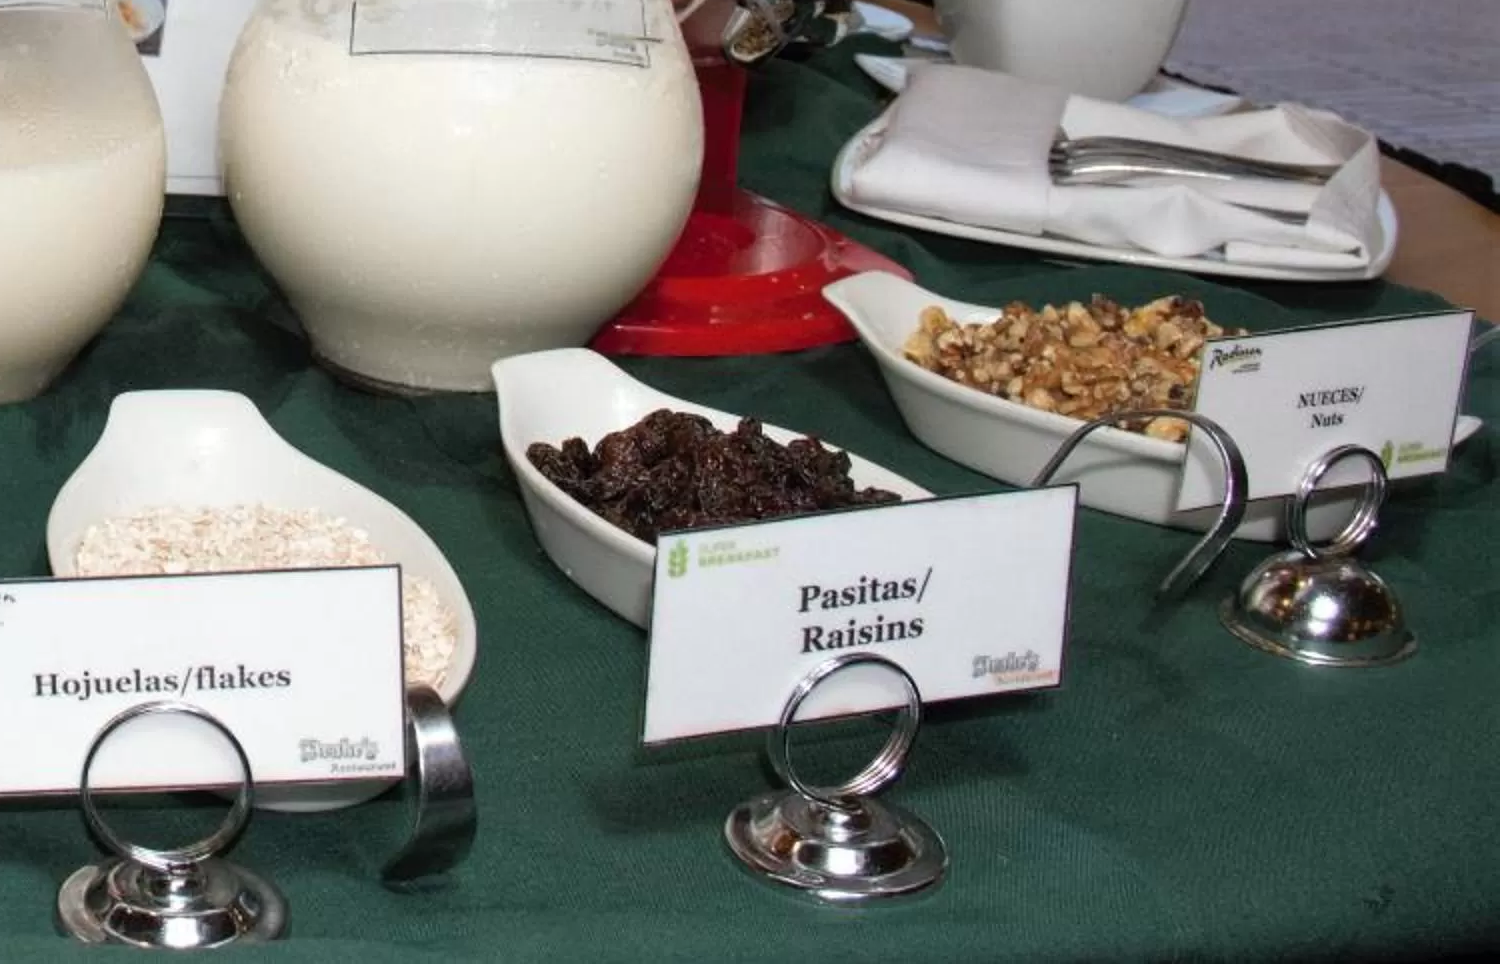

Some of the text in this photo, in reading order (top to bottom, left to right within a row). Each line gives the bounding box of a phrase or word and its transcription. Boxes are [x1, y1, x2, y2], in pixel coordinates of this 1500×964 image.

[1297, 386, 1365, 409] NUECES/
[1310, 412, 1344, 429] Nuts
[798, 566, 933, 613] Pasitas/
[800, 615, 924, 653] Raisins
[33, 664, 292, 702] Hojuelas/flakes
